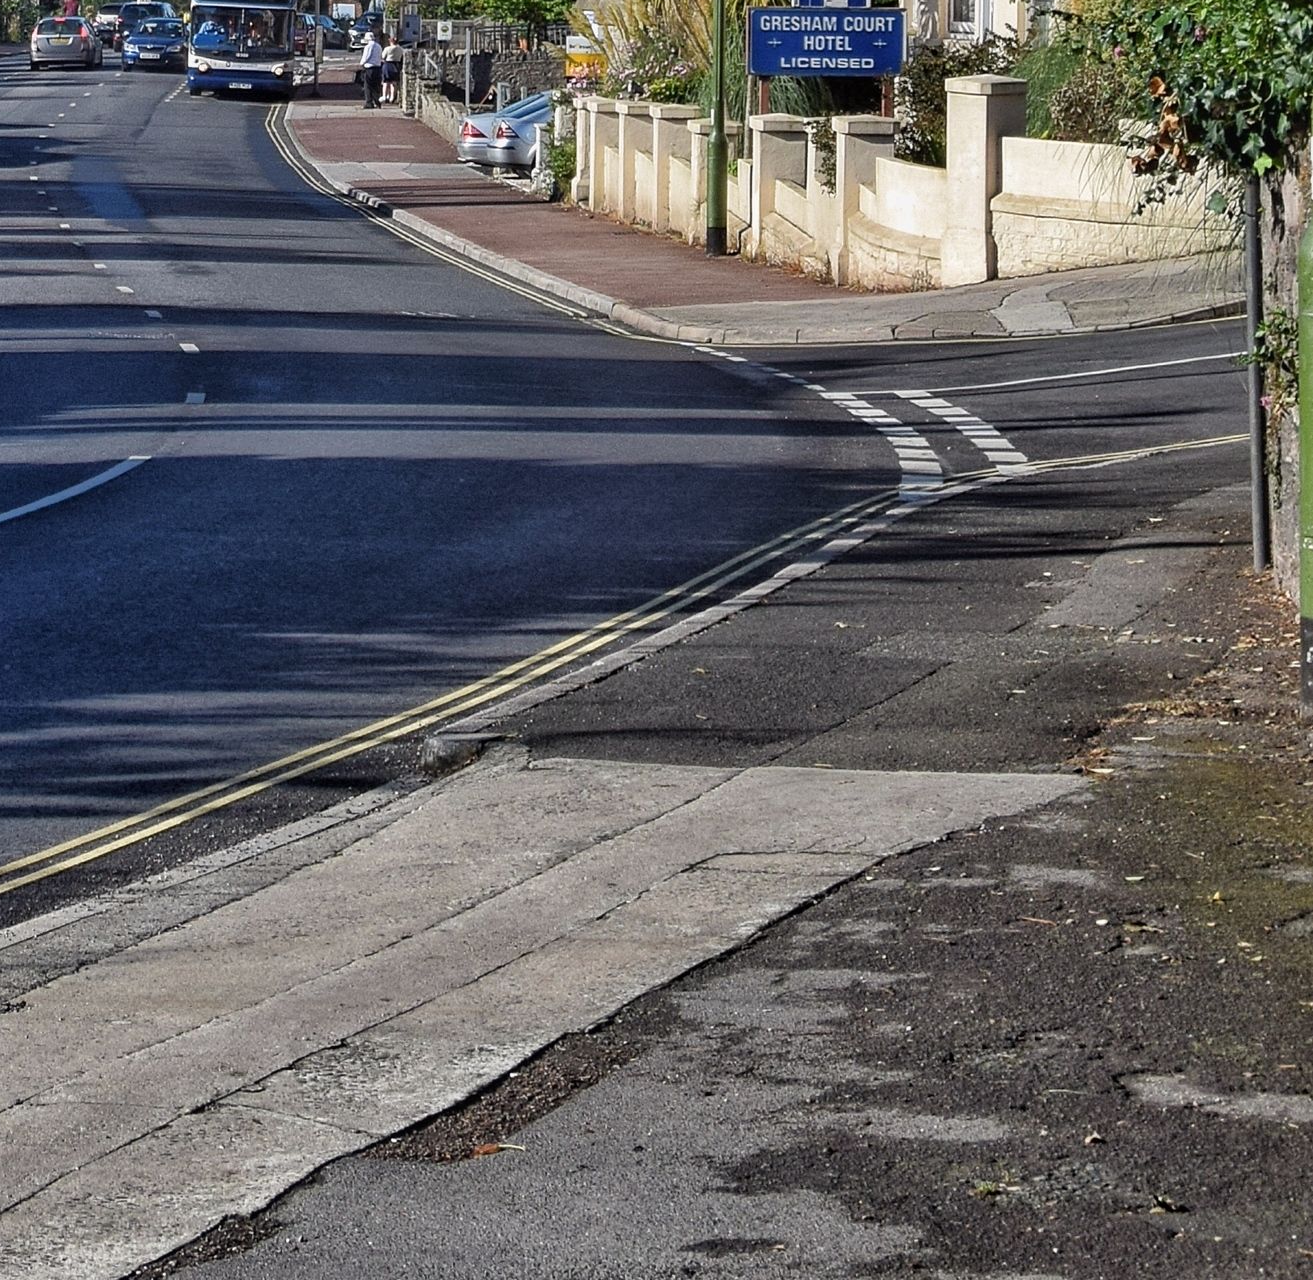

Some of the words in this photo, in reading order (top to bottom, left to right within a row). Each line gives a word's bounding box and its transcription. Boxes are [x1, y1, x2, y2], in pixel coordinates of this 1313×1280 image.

[760, 15, 837, 31] GRESHAM
[843, 16, 896, 32] COURT
[803, 35, 852, 51] HOTEL
[780, 57, 875, 69] LICENSED
